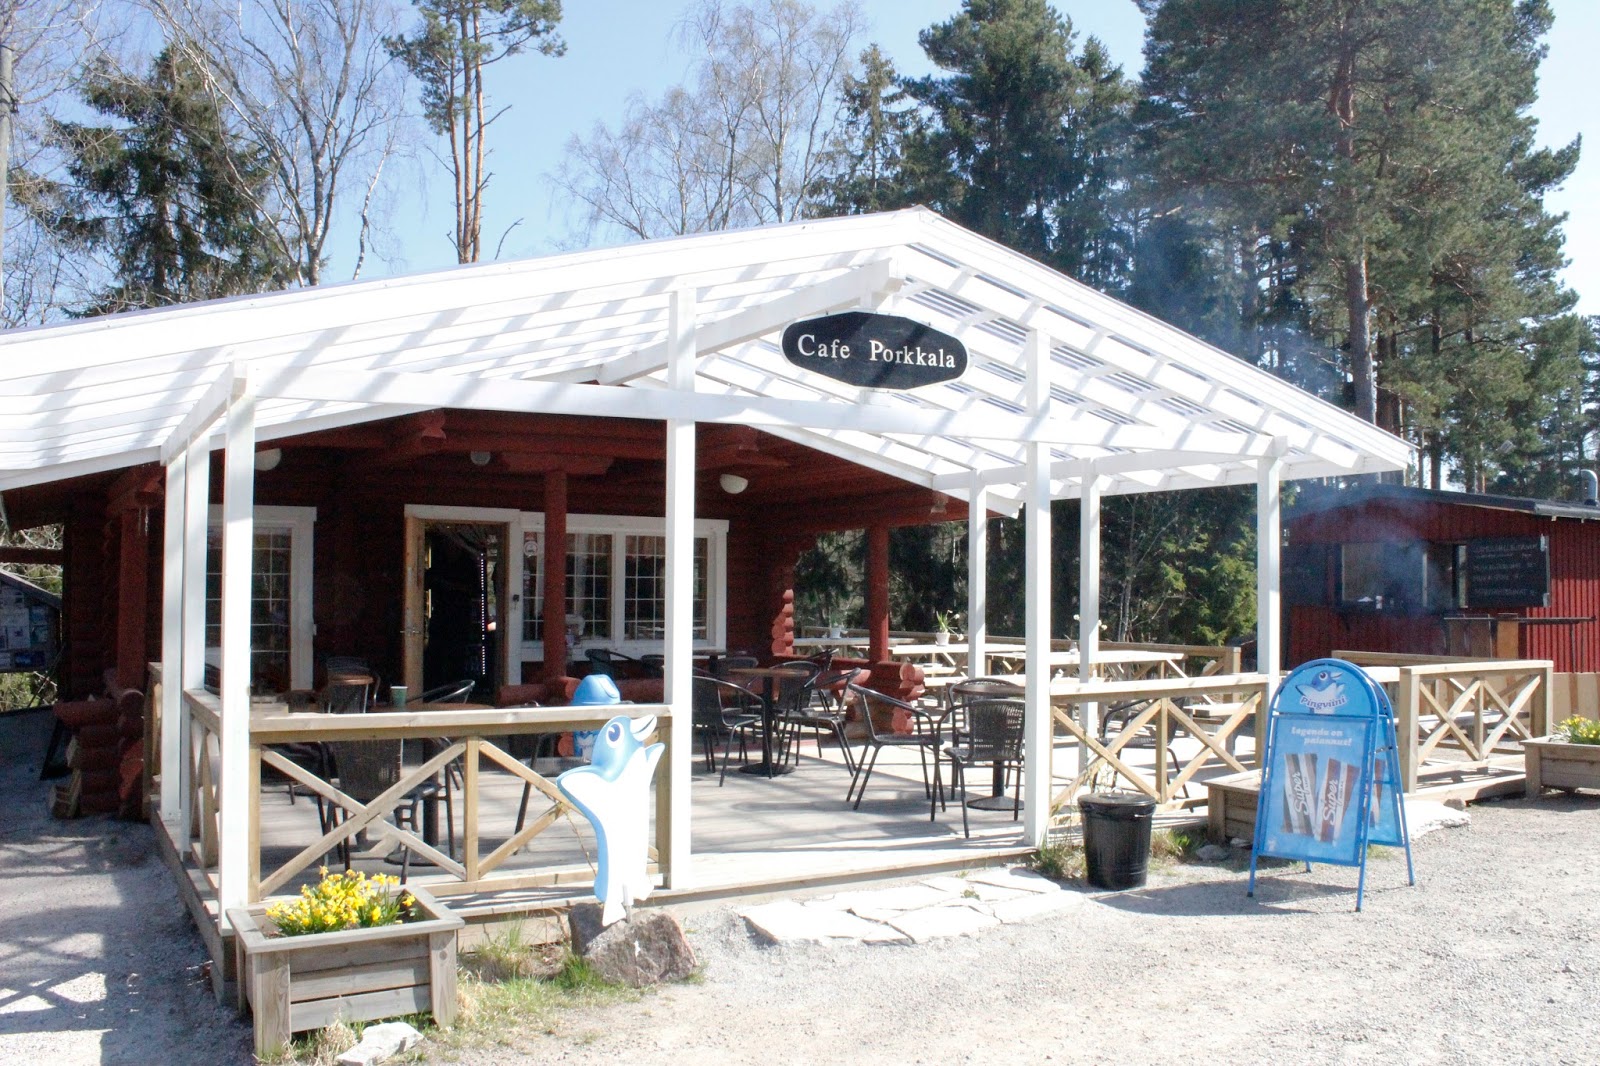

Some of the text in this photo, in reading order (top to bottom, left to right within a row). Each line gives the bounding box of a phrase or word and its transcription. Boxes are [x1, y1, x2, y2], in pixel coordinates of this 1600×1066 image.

[797, 334, 956, 368] Cafe Porkkala
[1300, 696, 1346, 710] Pingviini
[1291, 772, 1310, 816] Super
[1322, 779, 1343, 826] Super
